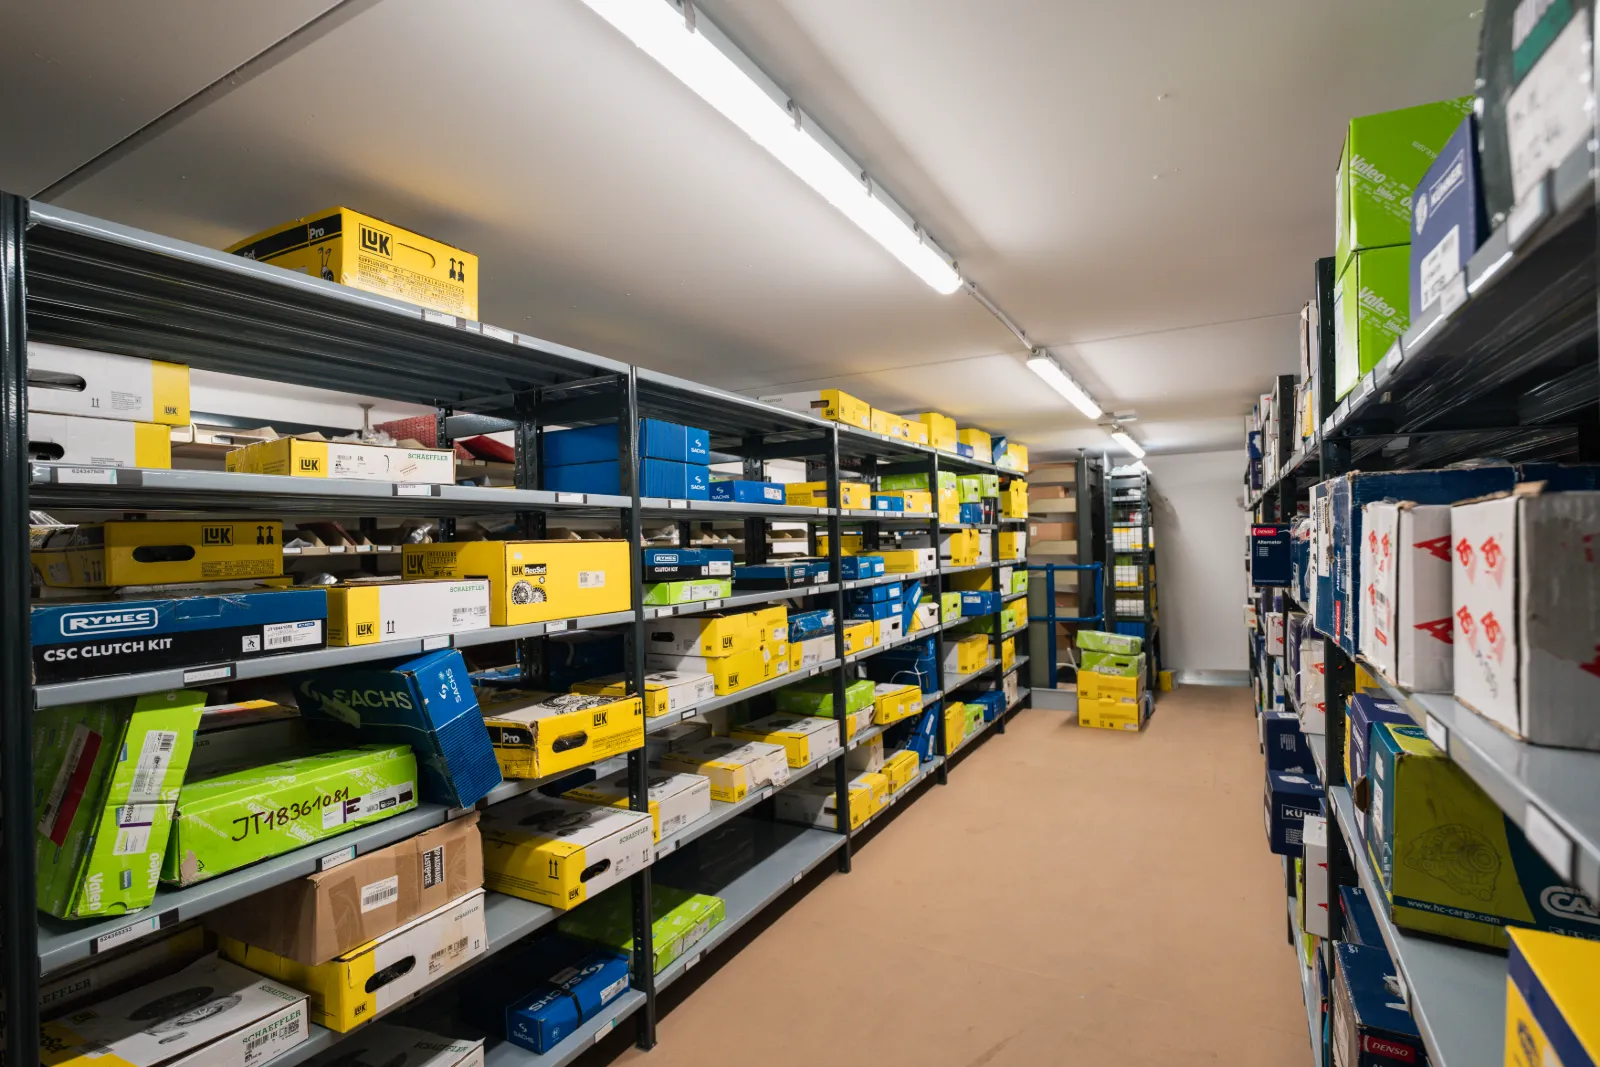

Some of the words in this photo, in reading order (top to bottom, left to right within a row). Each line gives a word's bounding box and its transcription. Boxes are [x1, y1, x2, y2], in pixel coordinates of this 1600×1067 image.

[1350, 153, 1386, 184] Valeo
[309, 227, 325, 240] Pro
[1360, 286, 1396, 317] Valeo
[407, 452, 449, 462] SCHAEFFLER
[690, 447, 706, 455] SACHS
[449, 584, 485, 593] SCHAEFFLER
[70, 612, 150, 631] RYMEC
[43, 647, 78, 662] CSC
[81, 640, 144, 658] CLUTCH
[148, 638, 173, 651] KIT
[445, 667, 462, 704] SACHS
[332, 689, 413, 710] SACHS
[502, 732, 520, 744] Pro
[232, 786, 349, 842] JT18361081
[290, 822, 315, 843] Valeo
[147, 852, 160, 889] Valeo
[89, 872, 104, 911] Valeo
[1407, 899, 1500, 924] www.hc-cargo.com
[242, 1009, 302, 1045] SCHAEFFLER
[1371, 1041, 1409, 1058] DENSO
